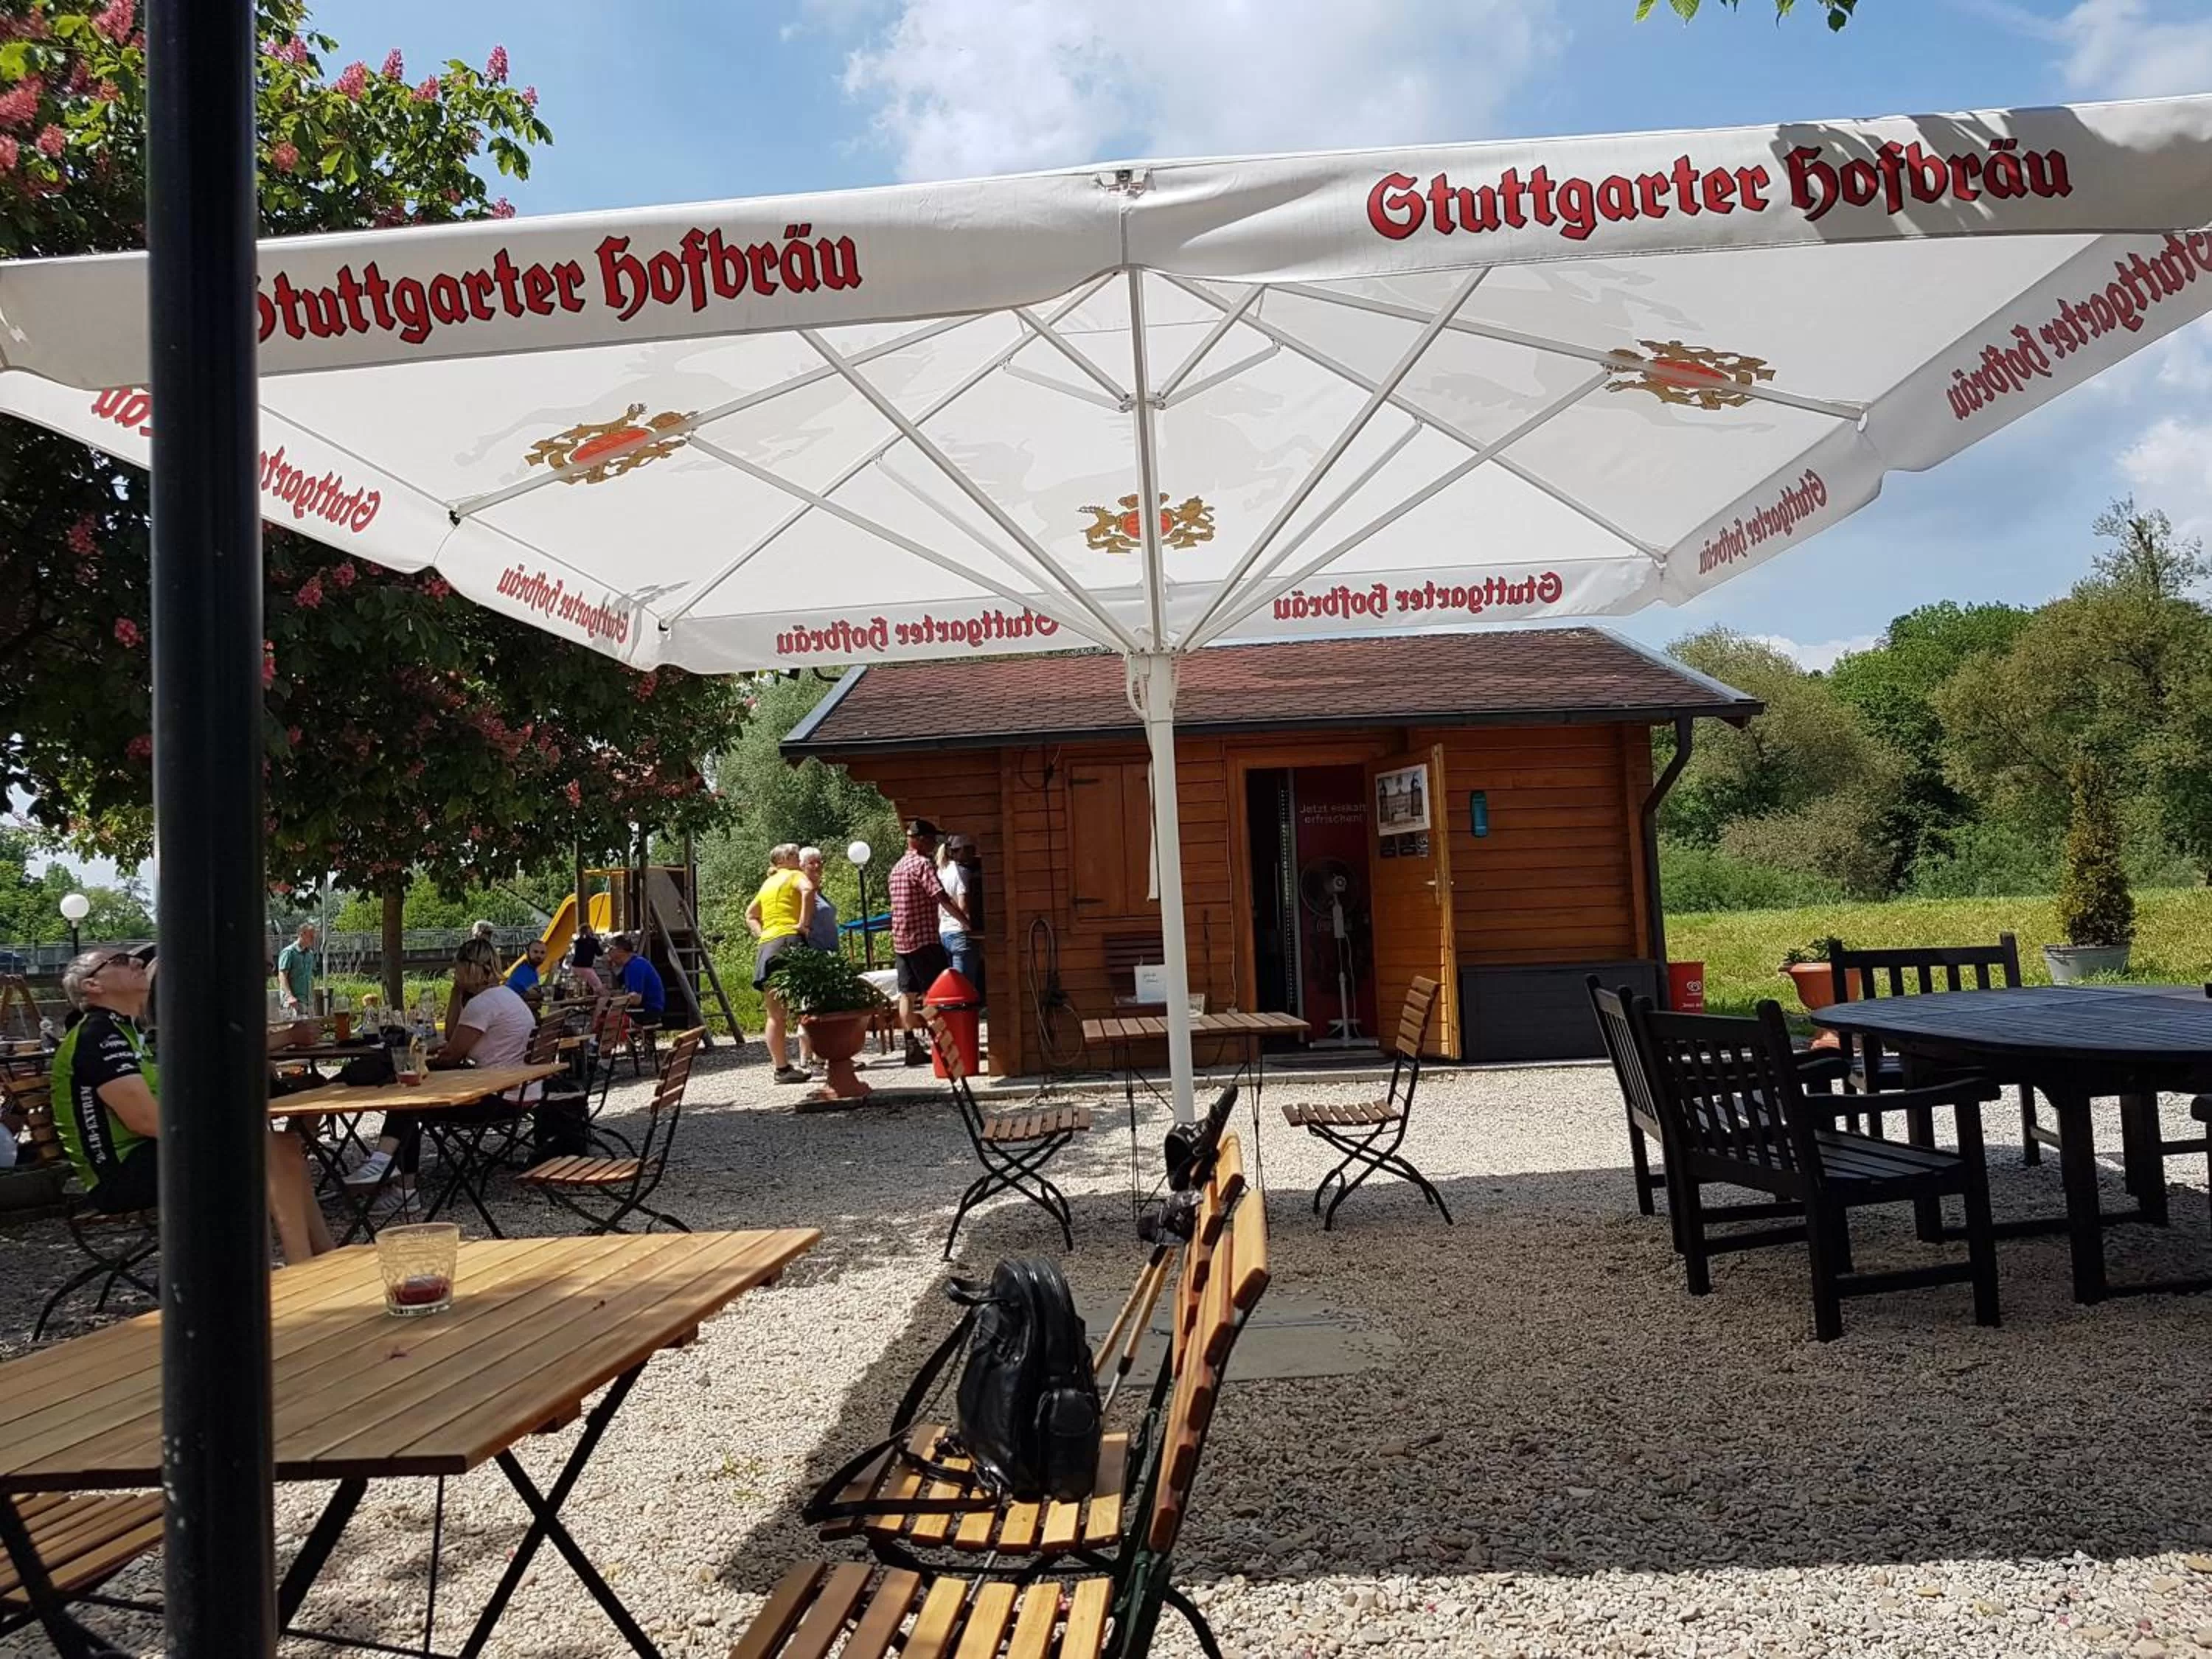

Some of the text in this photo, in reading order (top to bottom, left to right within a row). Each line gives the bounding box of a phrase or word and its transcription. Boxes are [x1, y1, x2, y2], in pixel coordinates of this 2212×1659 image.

[1366, 138, 2072, 240] Stuttgarter Hofbräu
[595, 223, 863, 320] Hofbräu
[1299, 802, 1327, 814] Jetzt
